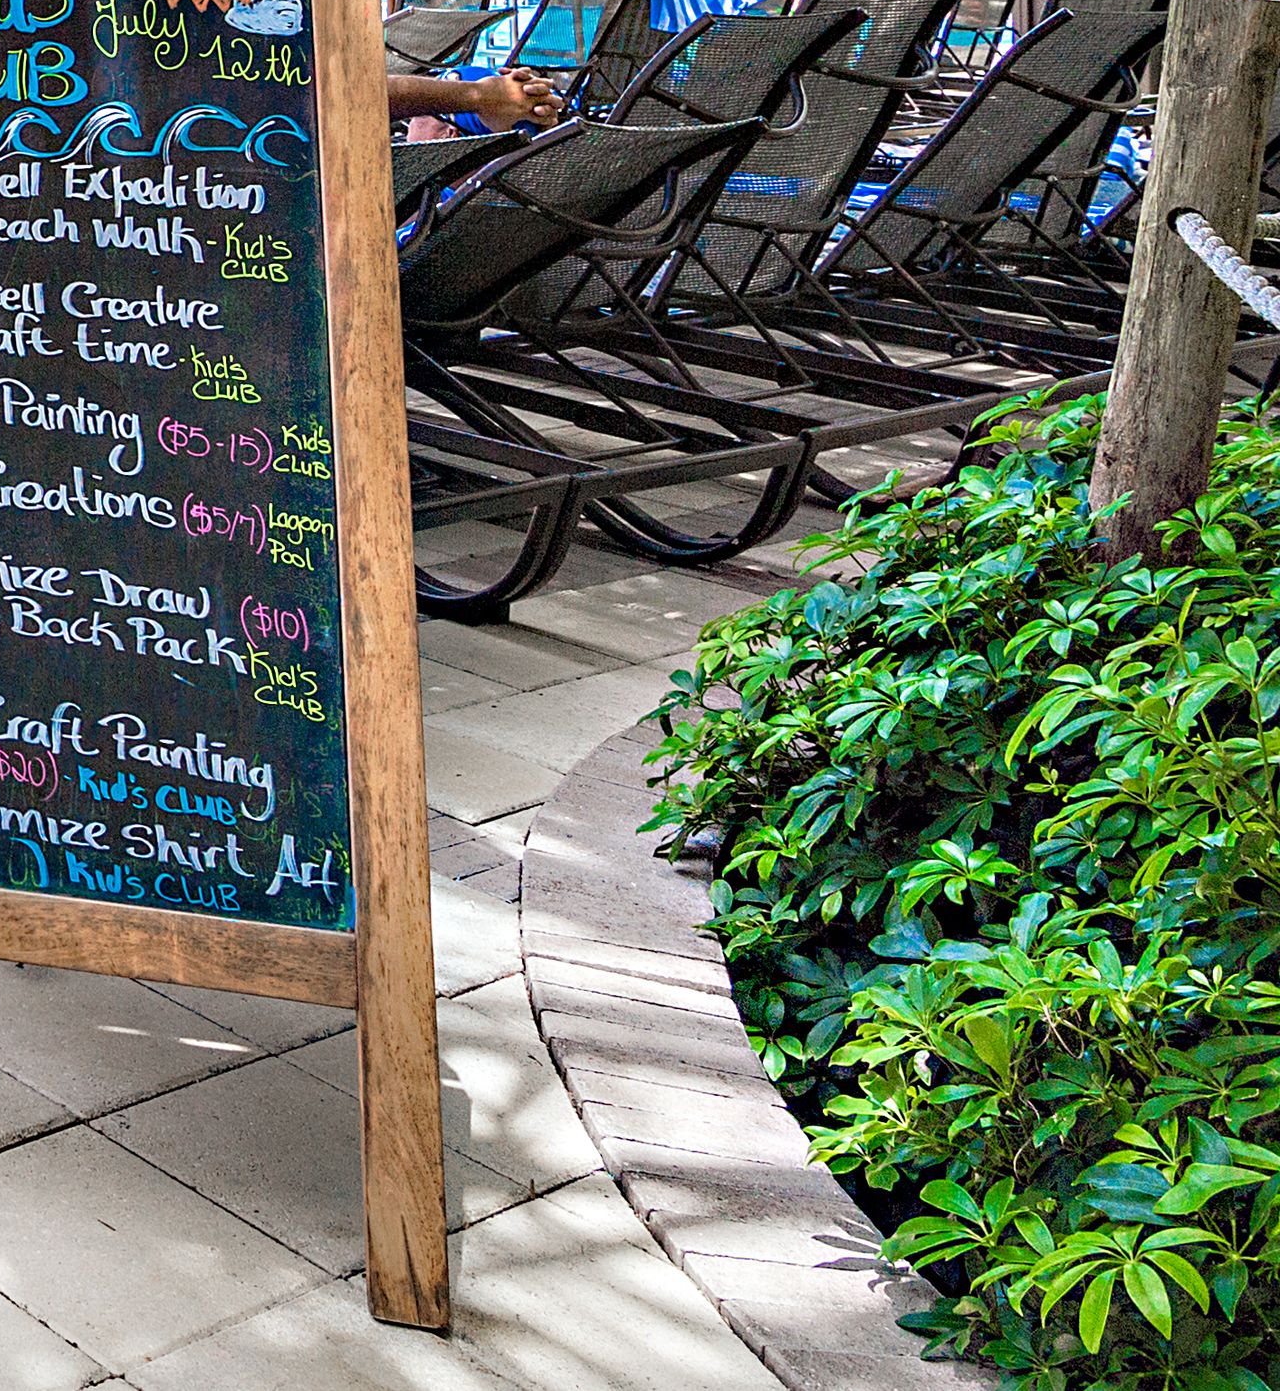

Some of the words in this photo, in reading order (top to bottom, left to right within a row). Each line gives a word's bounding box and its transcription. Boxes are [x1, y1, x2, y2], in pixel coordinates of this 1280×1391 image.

[61, 162, 266, 217] Expedition
[62, 281, 224, 330] Creature
[268, 503, 334, 545] Lagoon
[268, 538, 315, 572] Pool
[80, 568, 211, 619] Draw
[241, 595, 309, 651] ($10)
[97, 713, 277, 822] Painting
[65, 850, 145, 899] Kid's
[121, 824, 255, 878] Shirt
[265, 833, 339, 906] Art
